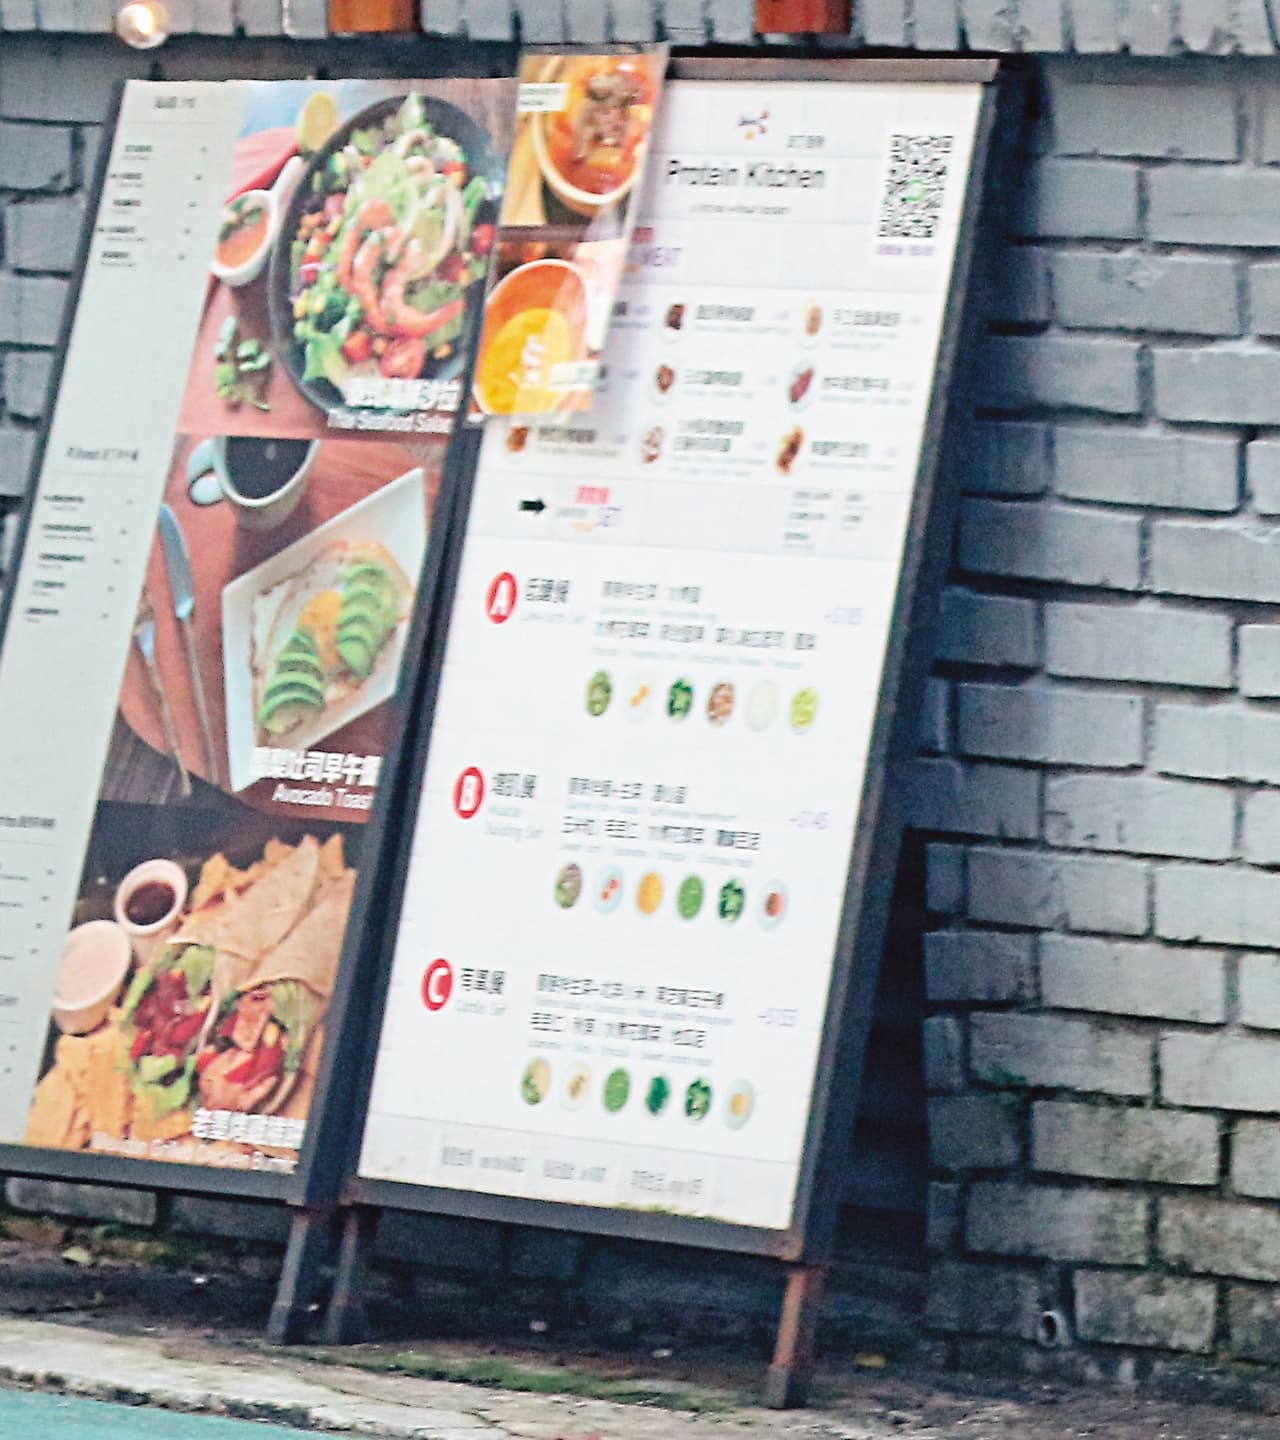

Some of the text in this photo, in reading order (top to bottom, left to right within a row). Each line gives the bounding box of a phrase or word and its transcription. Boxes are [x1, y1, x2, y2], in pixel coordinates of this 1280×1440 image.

[667, 158, 826, 189] Protein Kitchen
[272, 783, 333, 807] Avocado
